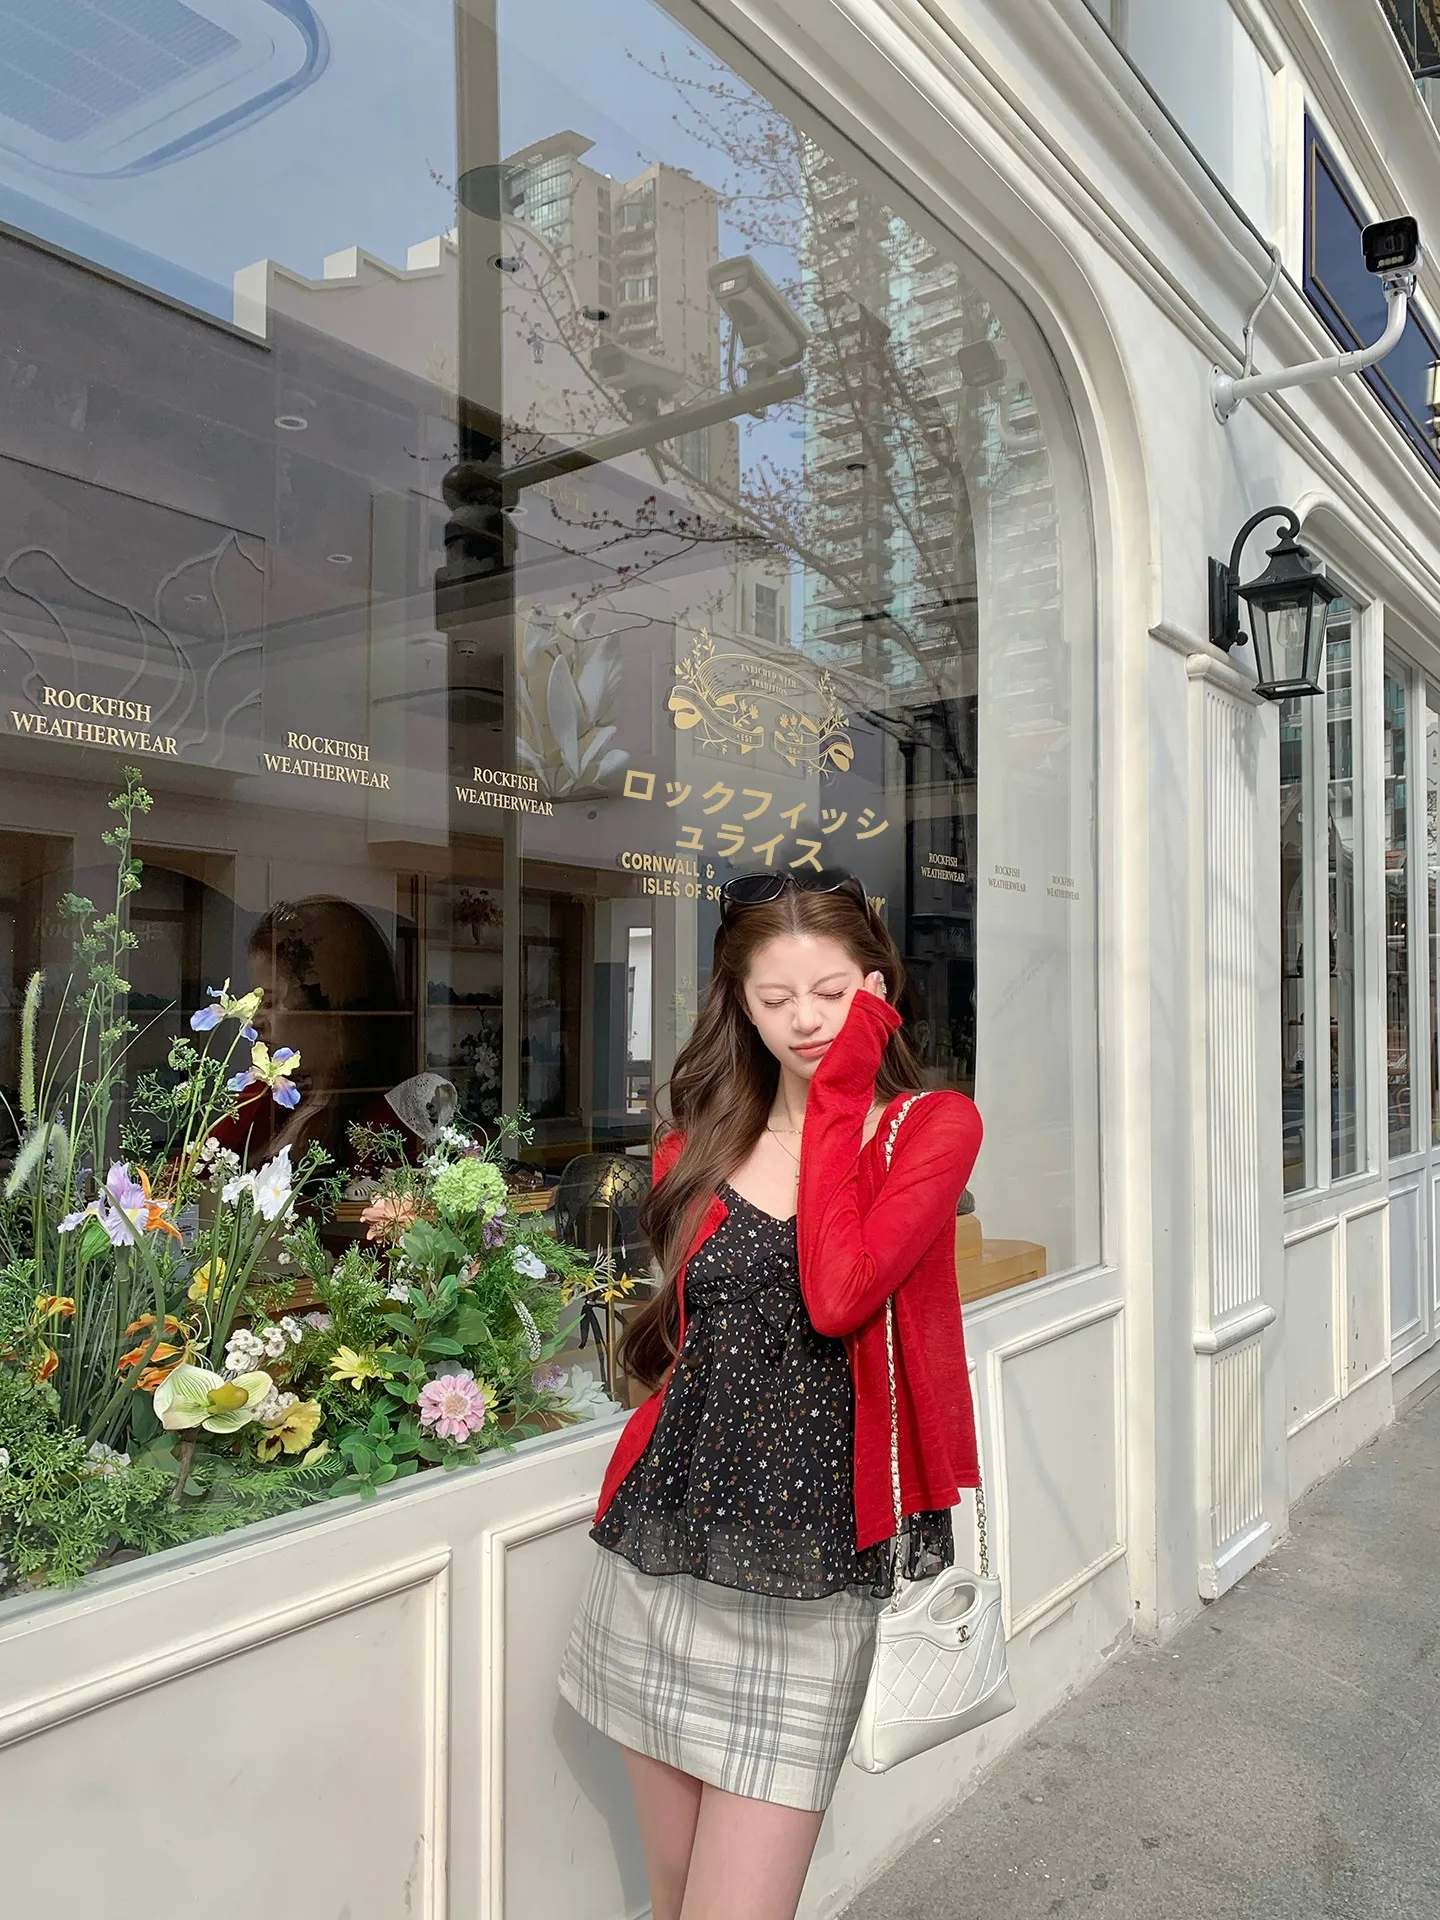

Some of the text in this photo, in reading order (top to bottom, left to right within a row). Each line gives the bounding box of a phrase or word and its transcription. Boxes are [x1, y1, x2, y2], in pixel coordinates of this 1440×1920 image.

[43, 686, 152, 723] ROCKFISH
[11, 711, 178, 755] WEATHERWEAR
[287, 731, 370, 762] ROCKFISH
[263, 753, 391, 790] WEATHERWEAR
[473, 766, 538, 793] ROCKFISH
[455, 786, 554, 817] WEATHERWEAR
[623, 770, 889, 840] ロックフィッシ
[621, 851, 715, 880] CORNWALL &
[928, 852, 958, 868] ROCKFISH
[994, 865, 1021, 878] ROCKFISH
[643, 877, 680, 897] ISLES
[685, 882, 703, 899] OF
[920, 866, 966, 884] WEATHERWEAR
[987, 878, 1027, 893] WEATHERWEAR
